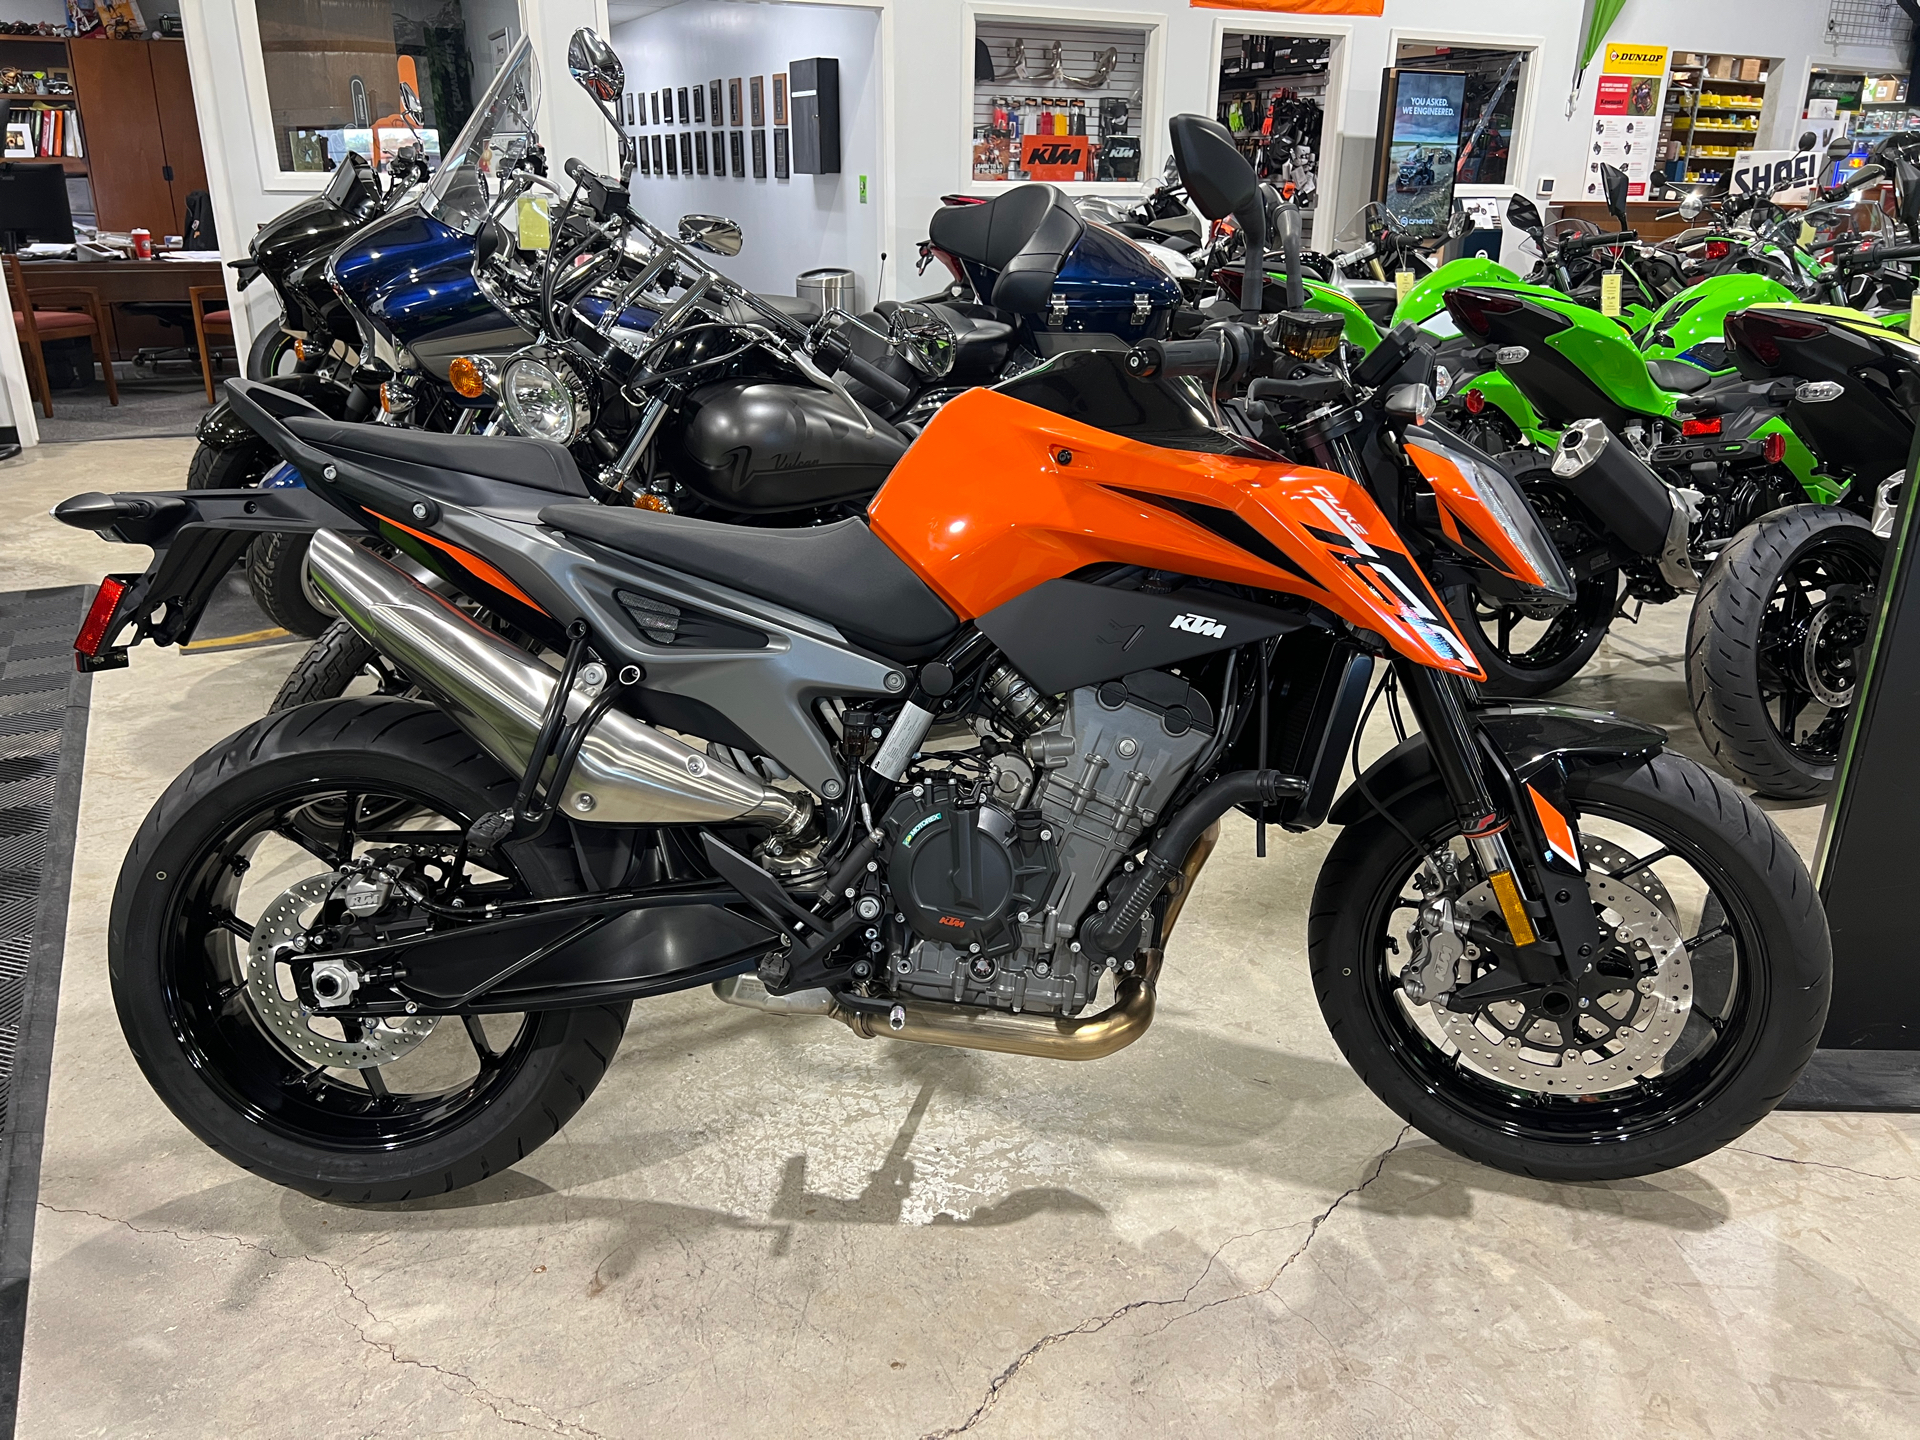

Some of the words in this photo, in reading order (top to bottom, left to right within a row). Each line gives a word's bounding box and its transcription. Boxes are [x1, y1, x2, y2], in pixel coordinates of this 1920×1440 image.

[1620, 53, 1663, 62] DUNLOP
[1402, 106, 1413, 115] WE
[1413, 107, 1455, 116] ENGINEERED.
[1410, 97, 1426, 106] YOU
[1426, 98, 1449, 107] ASKED.
[1027, 143, 1082, 165] KTM
[1109, 146, 1135, 157] KTM
[1734, 154, 1816, 194] SHOEI
[770, 451, 820, 470] Vulcan
[1312, 485, 1369, 536] DUKE
[1169, 612, 1228, 639] KTM
[910, 812, 941, 836] MOTOREX
[351, 892, 379, 906] KTM
[938, 915, 965, 929] KTM
[1434, 944, 1454, 982] KTM
